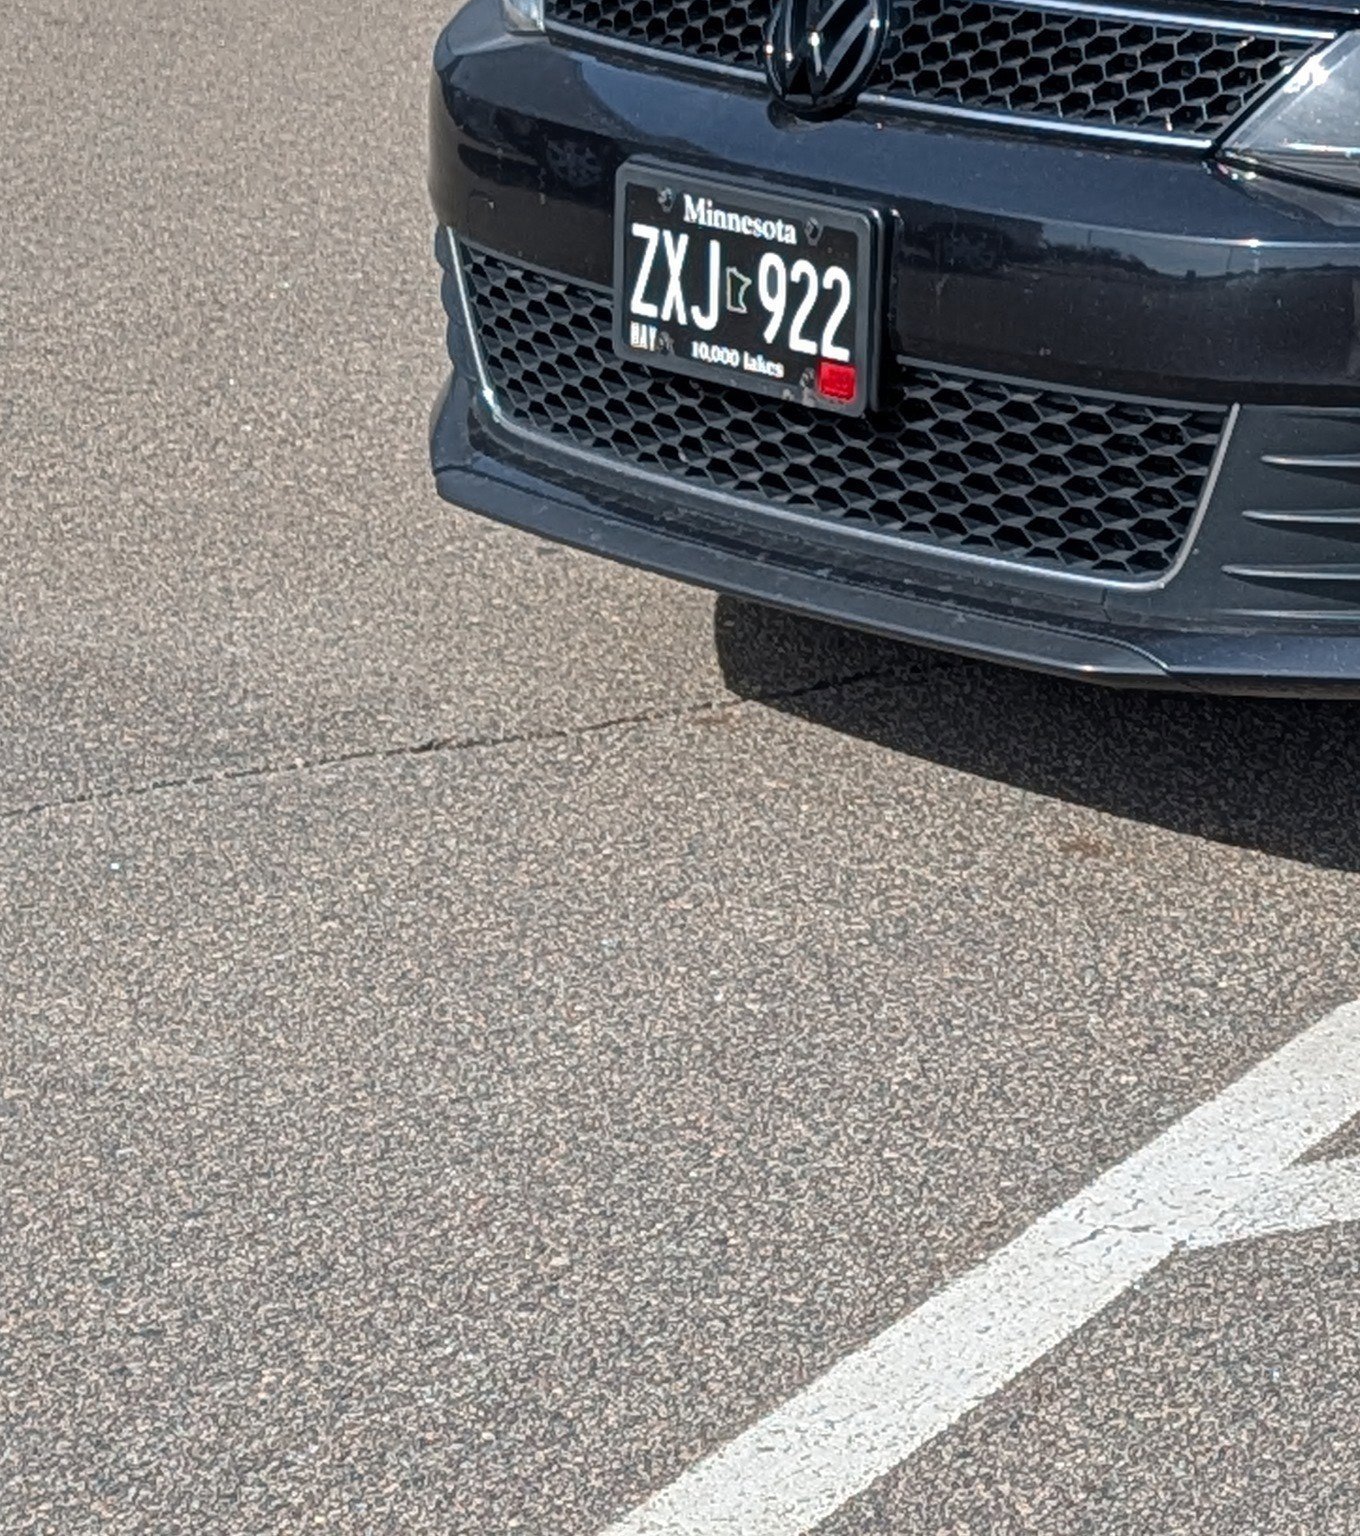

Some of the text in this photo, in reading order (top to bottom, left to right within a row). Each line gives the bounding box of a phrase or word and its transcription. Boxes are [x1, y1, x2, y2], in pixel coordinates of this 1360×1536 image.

[683, 193, 797, 245] Minnesota
[631, 223, 851, 362] ZXJ 922
[691, 341, 740, 369] 10,000
